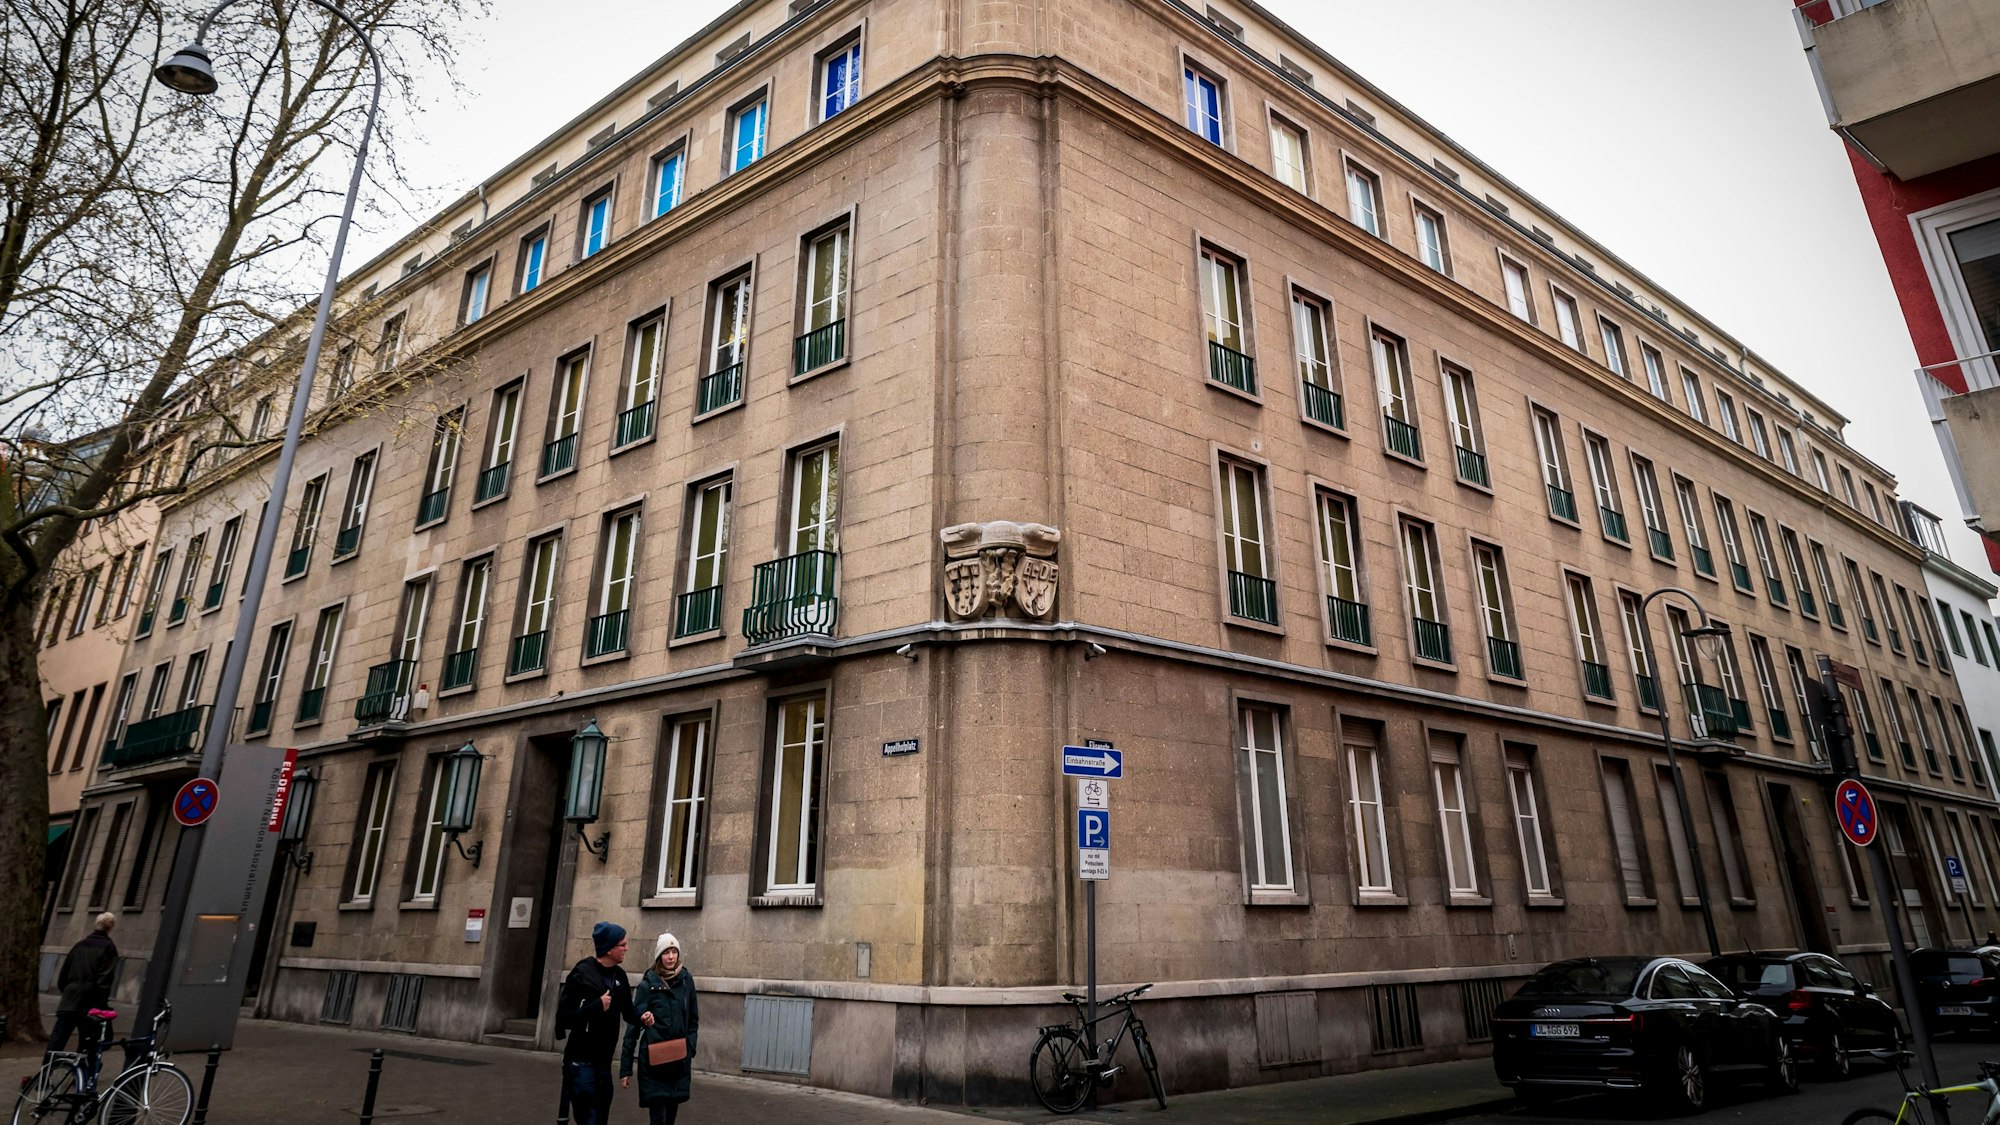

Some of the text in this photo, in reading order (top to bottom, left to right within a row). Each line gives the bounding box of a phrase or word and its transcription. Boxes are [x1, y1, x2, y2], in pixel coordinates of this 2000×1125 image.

[1066, 756, 1106, 767] Einbahnstraße
[265, 793, 274, 805] im
[1085, 815, 1102, 846] P
[241, 808, 272, 912] Nationalsozialismus
[1947, 859, 1957, 875] P
[1536, 1025, 1579, 1035] UL GG 692
